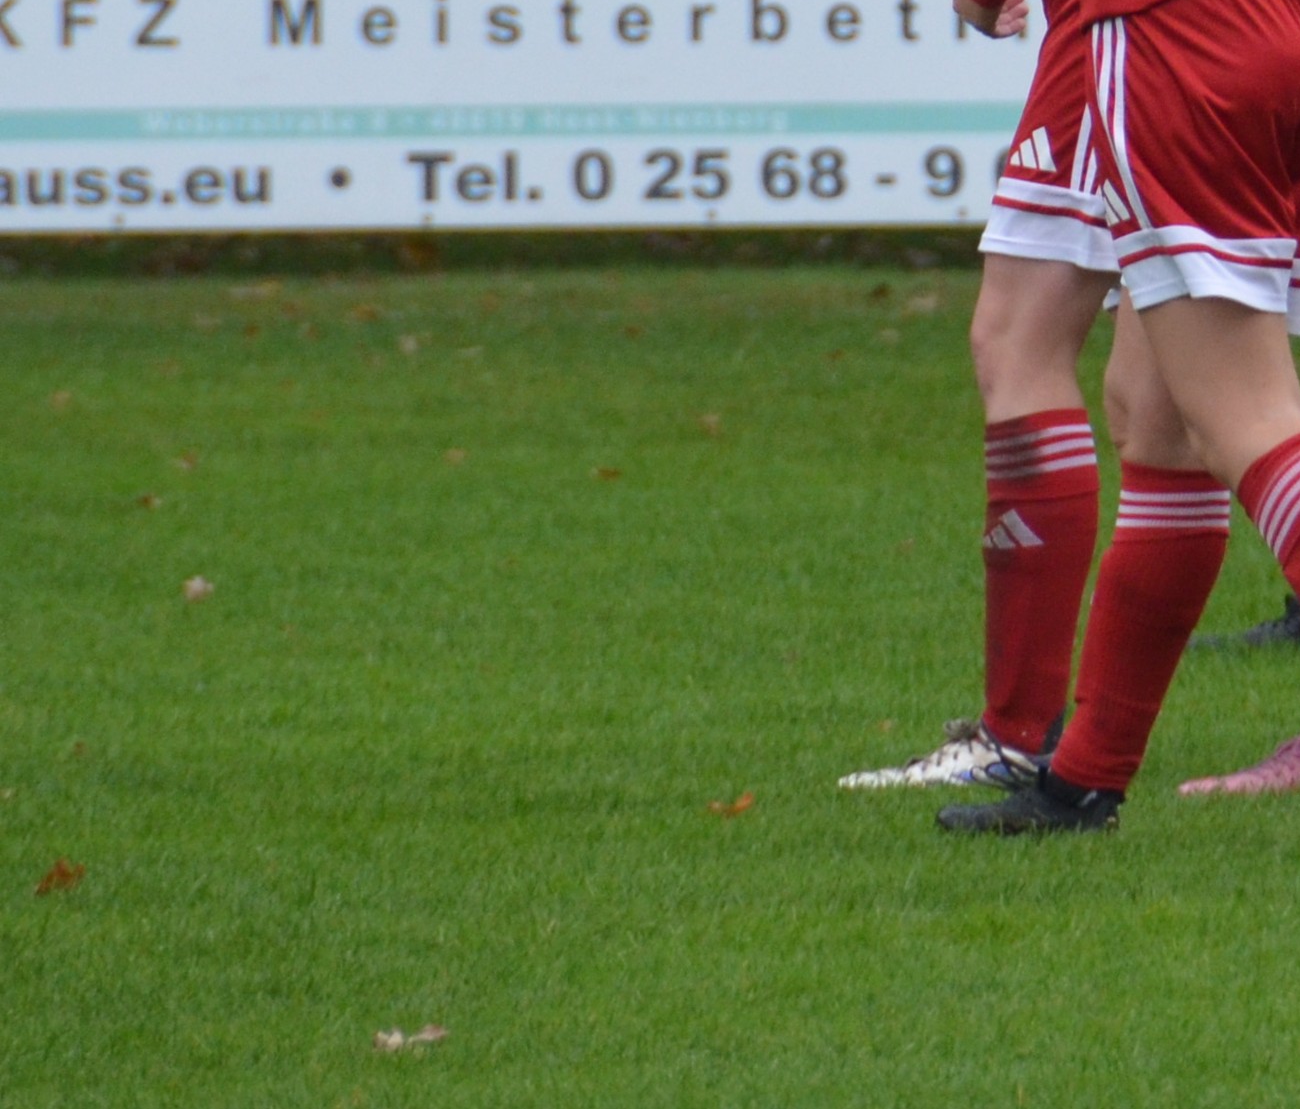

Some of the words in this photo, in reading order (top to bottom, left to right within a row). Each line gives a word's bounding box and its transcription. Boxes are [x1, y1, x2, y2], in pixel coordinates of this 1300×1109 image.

[408, 151, 541, 203] Tel.
[573, 149, 613, 201] 0
[644, 149, 731, 201] 25
[762, 148, 847, 200] 68
[925, 148, 964, 199] 9
